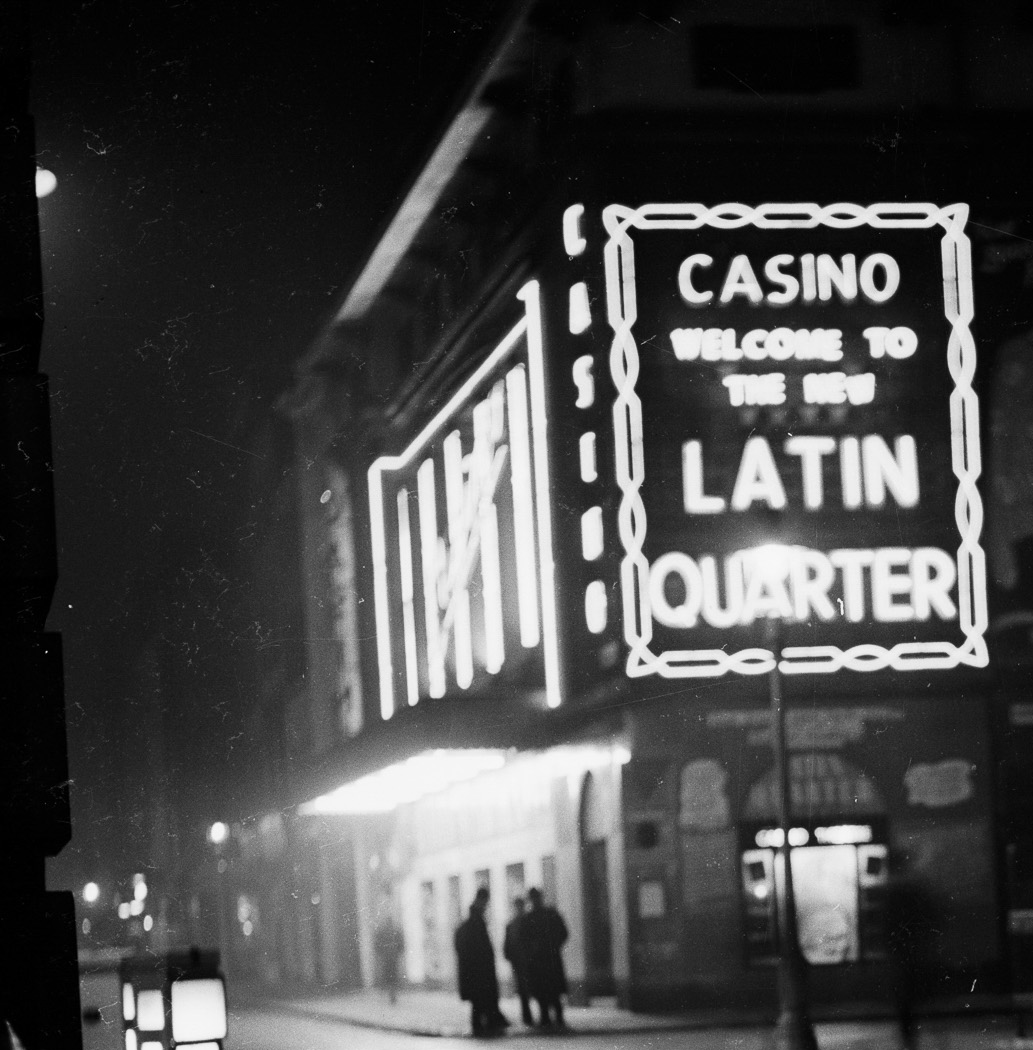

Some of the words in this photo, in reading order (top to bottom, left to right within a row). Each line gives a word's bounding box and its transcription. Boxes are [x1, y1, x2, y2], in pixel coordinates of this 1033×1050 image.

[677, 253, 901, 304] CASINO
[669, 328, 844, 361] WELCOME
[861, 327, 918, 359] TO
[722, 373, 786, 407] THE
[801, 372, 876, 405] NEW
[681, 434, 920, 514] LATIN
[648, 546, 957, 628] QUARTER
